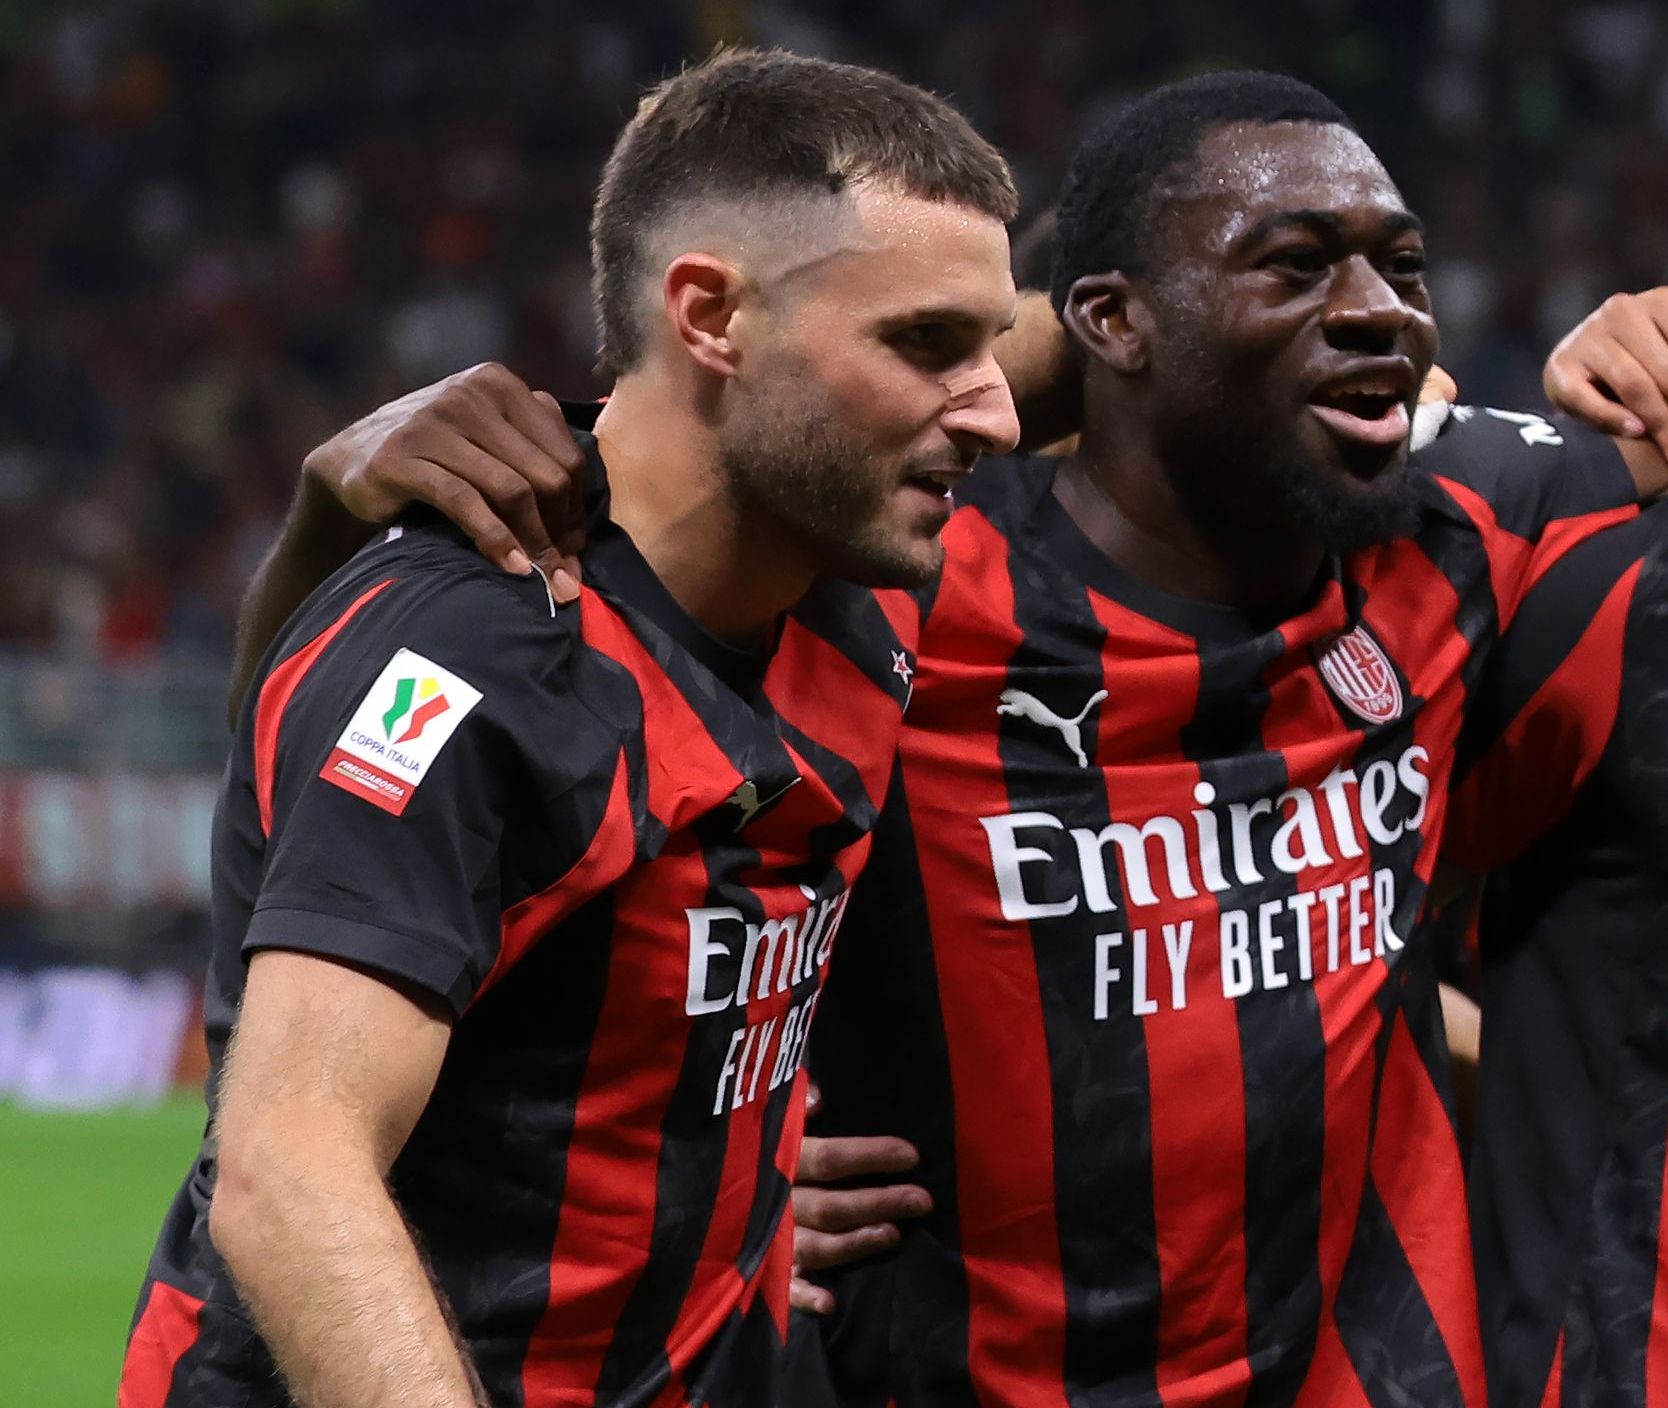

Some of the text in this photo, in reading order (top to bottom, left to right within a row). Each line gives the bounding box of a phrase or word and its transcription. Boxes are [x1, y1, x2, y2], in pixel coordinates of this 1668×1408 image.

[337, 760, 405, 798] FRECCIAROSSA
[350, 731, 420, 774] COPPA ITALIA
[977, 744, 1430, 922] Emirates
[1094, 866, 1405, 1021] FLY BETTER
[712, 1016, 778, 1116] FLY
